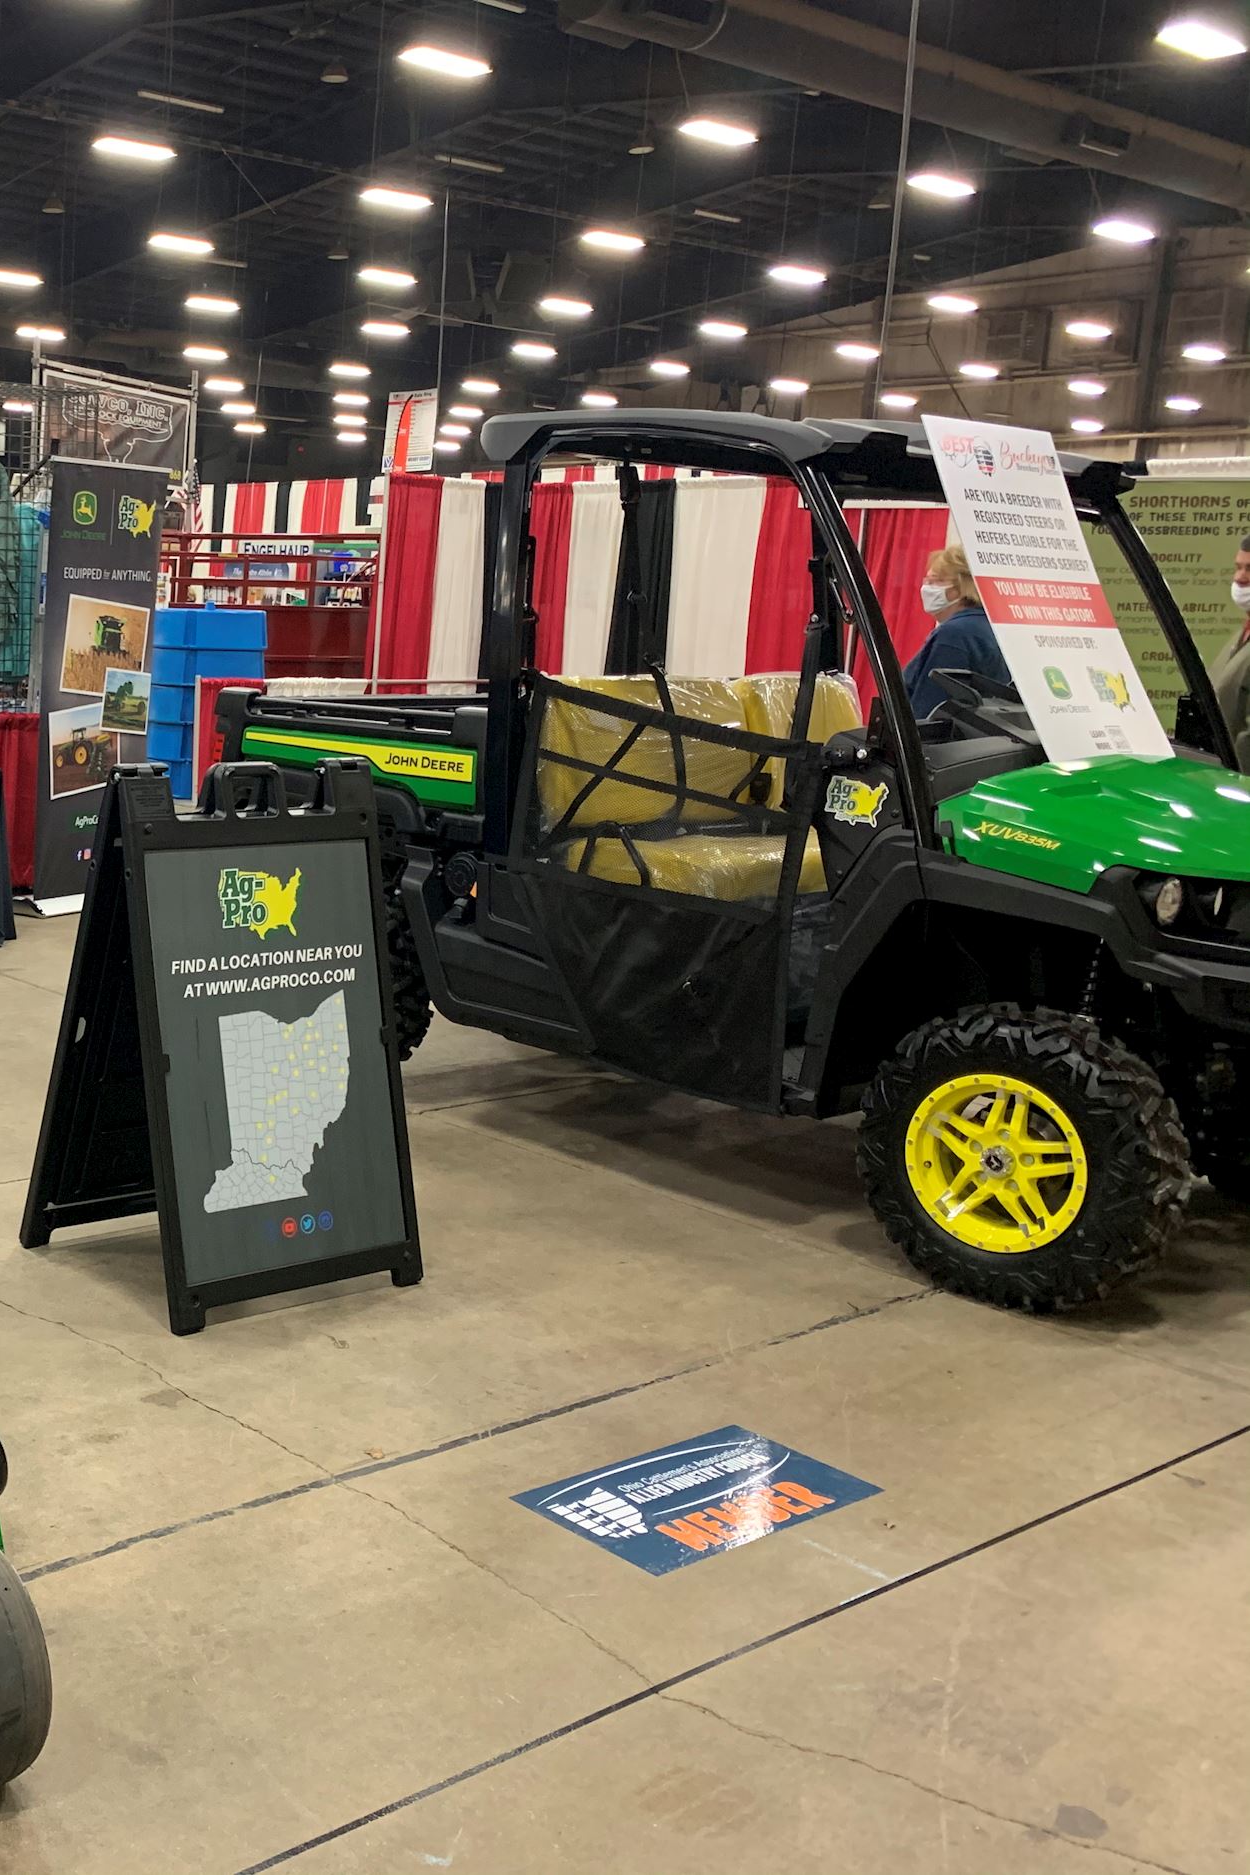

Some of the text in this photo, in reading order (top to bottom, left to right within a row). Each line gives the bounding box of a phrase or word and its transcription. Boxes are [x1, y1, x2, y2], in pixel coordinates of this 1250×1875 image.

[136, 400, 168, 421] INC.
[118, 415, 163, 429] EQUIPMENT
[964, 488, 1063, 510] ARE YOU A BREEDER WITH
[1129, 496, 1231, 508] SHORTHORNS
[974, 510, 1024, 526] REGISTERED
[1024, 515, 1055, 529] STEERS
[1150, 512, 1186, 521] THESE
[1193, 512, 1233, 522] TRAITS
[975, 530, 1011, 545] HEIFERS
[1010, 534, 1047, 548] ELIGIBLE
[1140, 526, 1219, 536] OSSBREEDING
[976, 551, 1016, 566] BUCKEYE
[1015, 554, 1058, 570] BREEDERS
[1152, 553, 1202, 563] DOCILITY
[63, 567, 102, 580] EQUIPPED
[993, 581, 1016, 596] YOU
[1016, 583, 1035, 598] MAY
[1035, 585, 1051, 599] BE
[1008, 605, 1097, 623] TO WIN THIS GATOR!
[1182, 603, 1227, 612] ABILITY
[1034, 635, 1084, 649] SPONSORED
[385, 752, 465, 773] JOHN DEERE
[830, 780, 858, 798] Ag-
[828, 795, 856, 811] Pro
[973, 821, 1062, 850] XUV835M
[220, 868, 265, 902] Ag-
[222, 898, 269, 928] Pro
[171, 944, 363, 975] FIND A LOCATION NEAR YOU
[183, 968, 356, 998] AT WWW.AGPROCO.COM
[617, 1481, 643, 1493] Ohio
[640, 1463, 697, 1486] Cattlemen's
[625, 1486, 673, 1505] ALLIED
[664, 1469, 724, 1491] INDUSTRY
